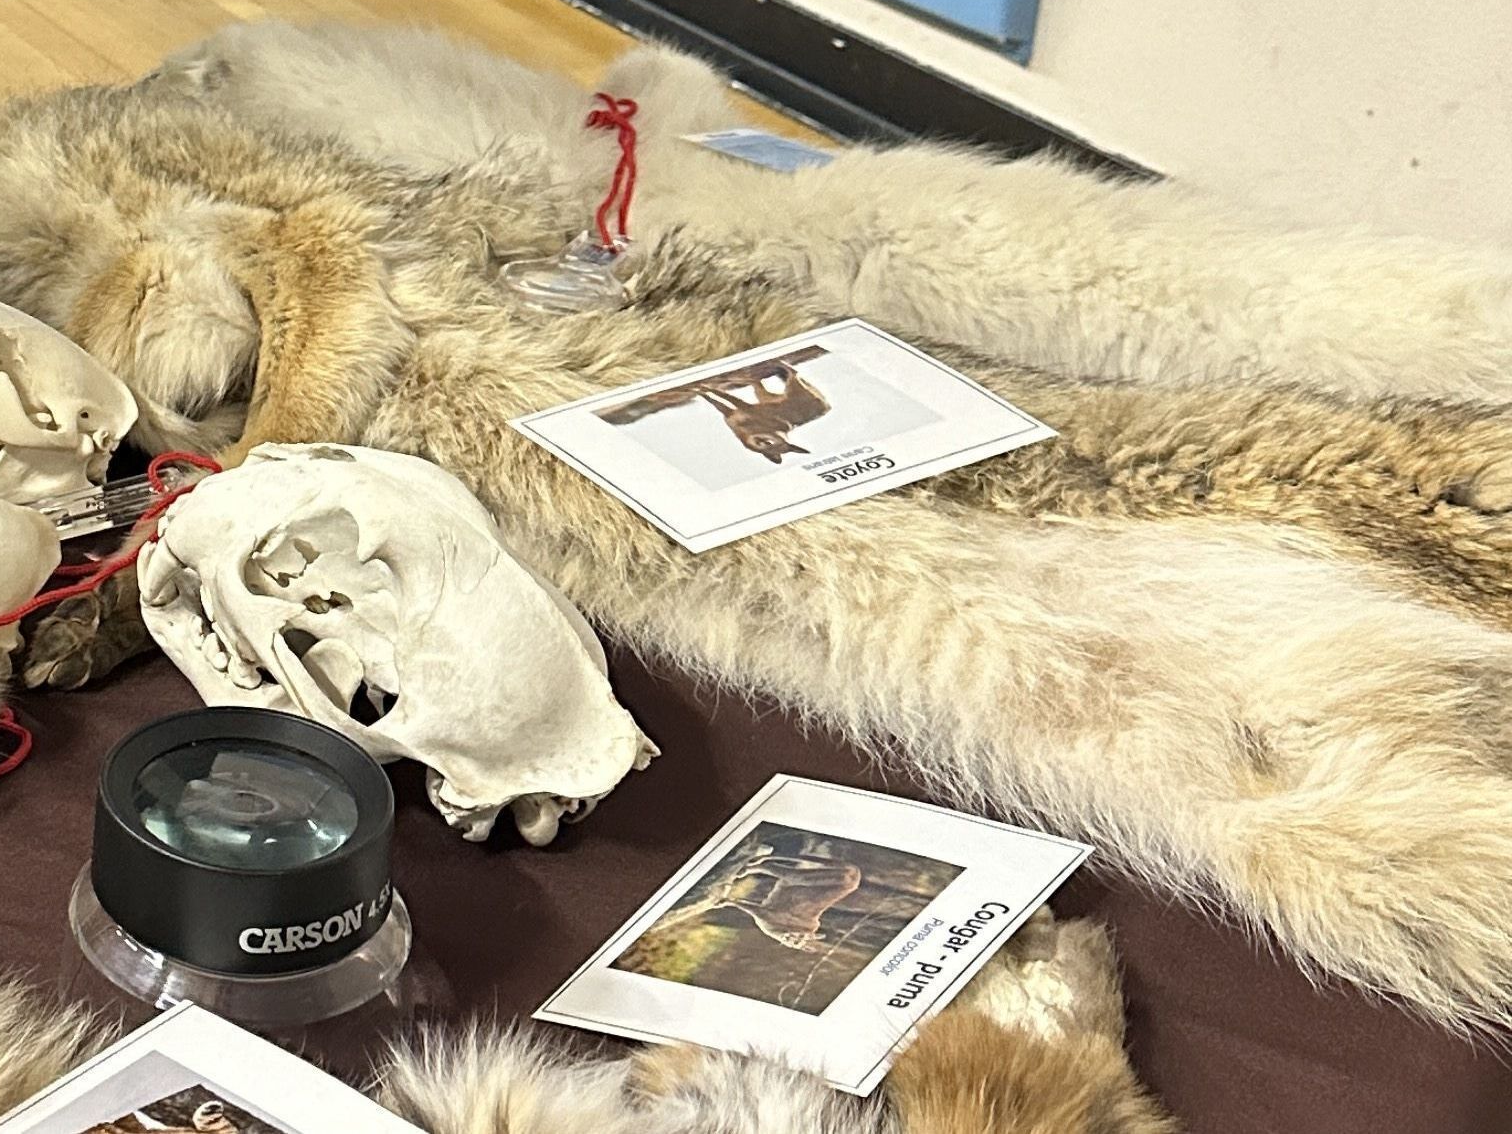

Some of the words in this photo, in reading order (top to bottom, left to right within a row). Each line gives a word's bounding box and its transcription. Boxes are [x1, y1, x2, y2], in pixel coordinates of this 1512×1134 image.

[820, 456, 896, 483] Coyote
[238, 902, 364, 954] CARSON
[913, 917, 945, 942] Puma
[942, 902, 1010, 953] Cougar
[886, 961, 943, 1008] puma
